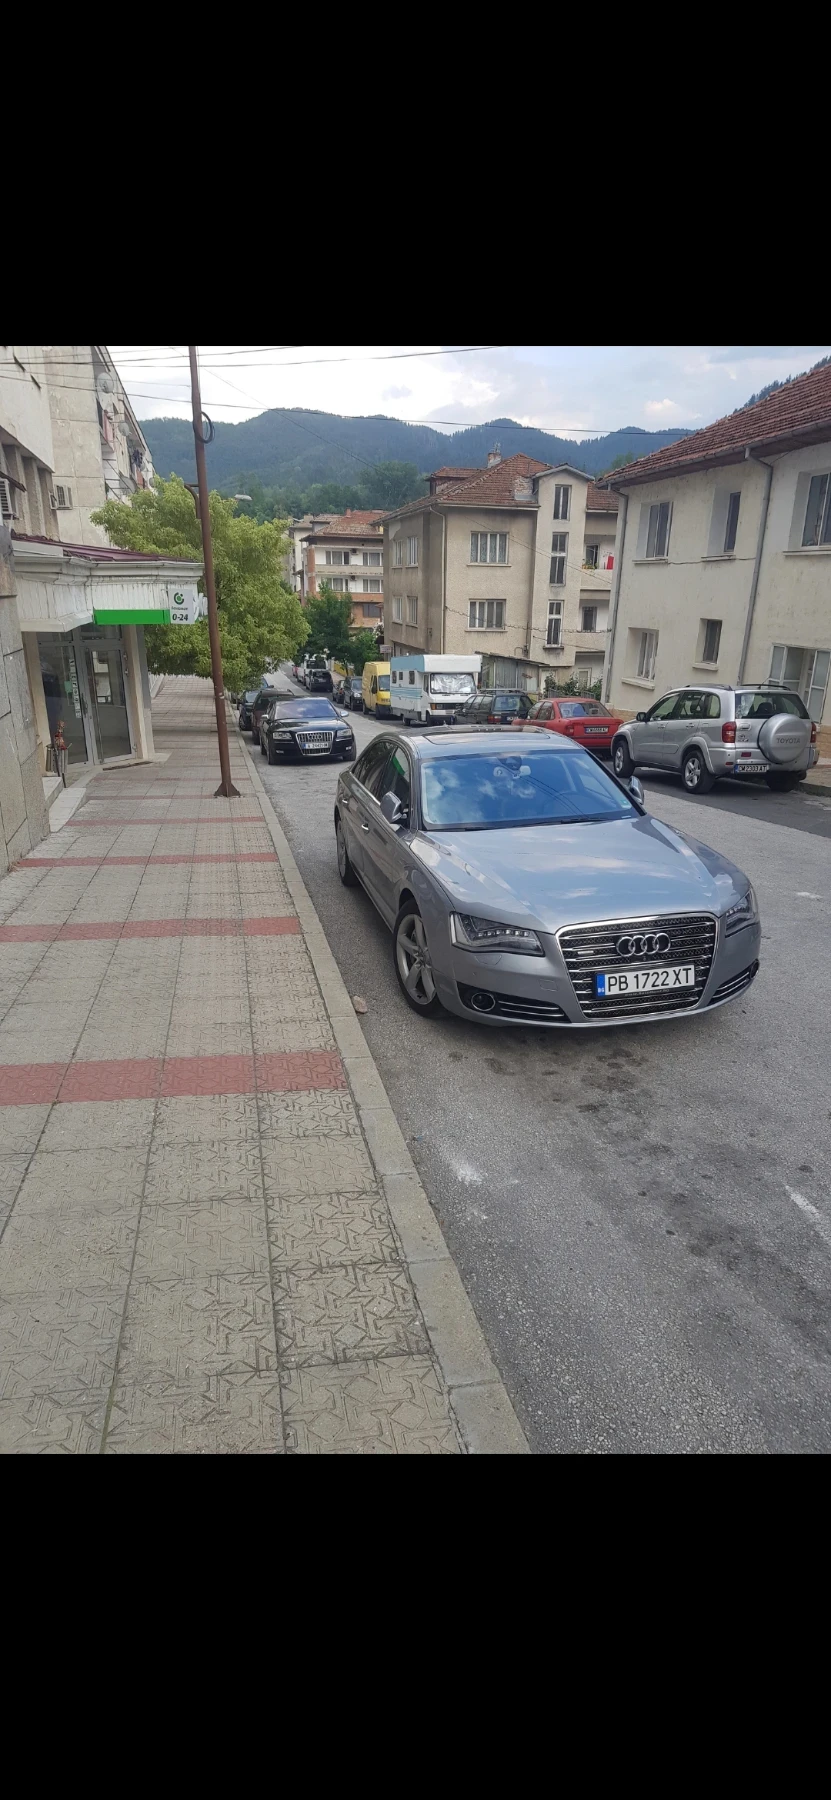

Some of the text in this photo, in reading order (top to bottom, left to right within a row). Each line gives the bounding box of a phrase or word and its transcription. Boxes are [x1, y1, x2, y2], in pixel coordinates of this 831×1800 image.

[172, 613, 188, 621] 0-24
[607, 967, 692, 992] PB 1722 XT
